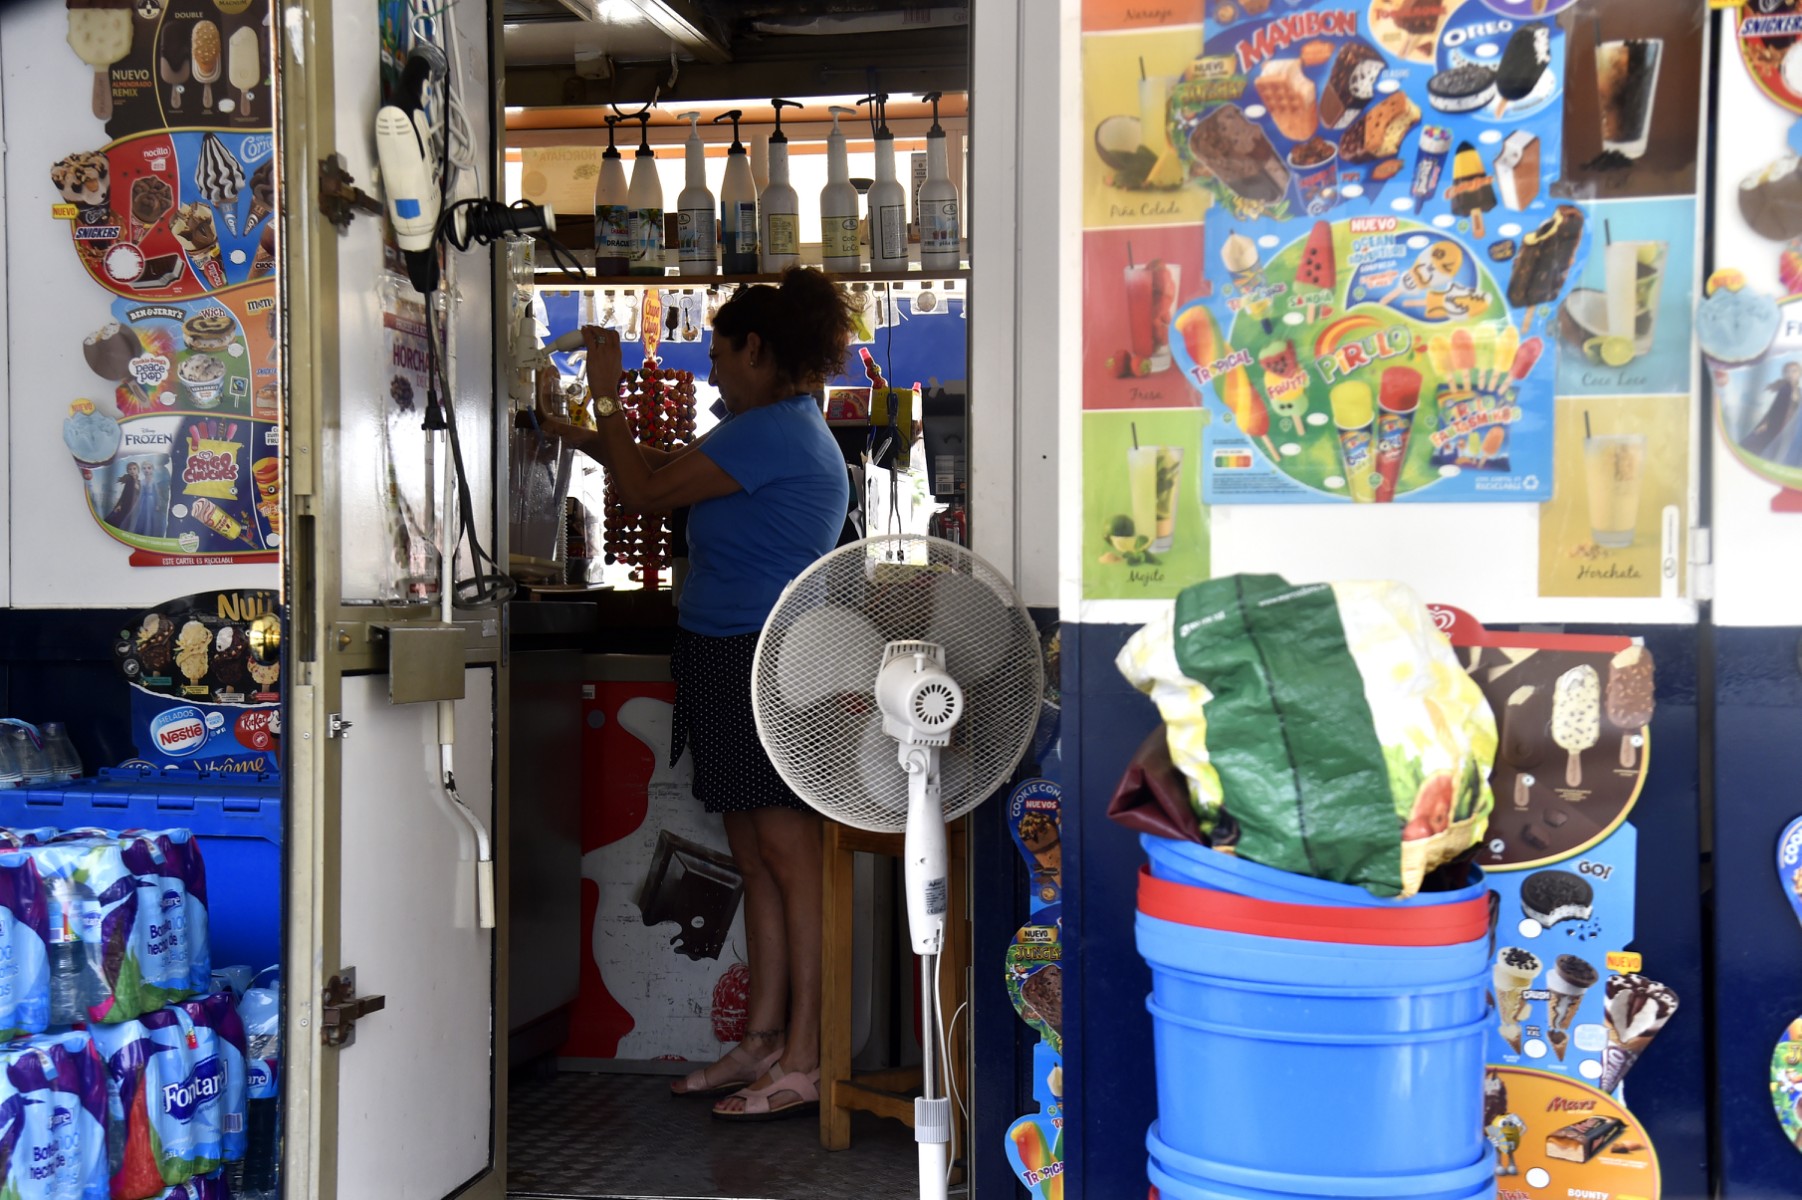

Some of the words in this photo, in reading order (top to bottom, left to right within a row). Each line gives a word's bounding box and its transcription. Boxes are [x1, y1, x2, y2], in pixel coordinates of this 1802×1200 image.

[174, 11, 204, 19] DOUBLE
[1741, 15, 1802, 35] SNICKER
[1442, 19, 1513, 47] OREO
[1237, 10, 1357, 74] MAXIBON
[112, 70, 149, 80] NUEVO
[112, 88, 138, 97] REMIX
[143, 147, 169, 158] nocilla
[53, 207, 76, 216] NUEVO
[1140, 201, 1182, 216] Colada
[1350, 217, 1397, 232] NUEVO
[75, 227, 119, 238] SNICKERS
[1315, 324, 1411, 386] PIRULO
[135, 364, 166, 376] peace
[1190, 349, 1254, 385] TROPICAL
[140, 372, 163, 383] pop
[125, 433, 173, 446] FROZEN
[162, 557, 175, 566] ESTE
[175, 557, 195, 565] CARTEL
[196, 557, 203, 565] ES
[204, 556, 233, 566] RECICLABLE
[1126, 569, 1165, 587] Mojito
[1576, 562, 1642, 580] Horchata
[157, 709, 194, 725] HELADOS
[1012, 784, 1038, 817] COOKIE
[1025, 800, 1057, 809] NUEVOS
[1578, 860, 1614, 880] GO!
[1024, 929, 1049, 938] NUEVO
[1606, 955, 1640, 968] NUEVO
[1545, 1096, 1598, 1112] Mars
[1022, 1161, 1064, 1187] TROPICA
[1567, 1188, 1609, 1200] BOUNTY
